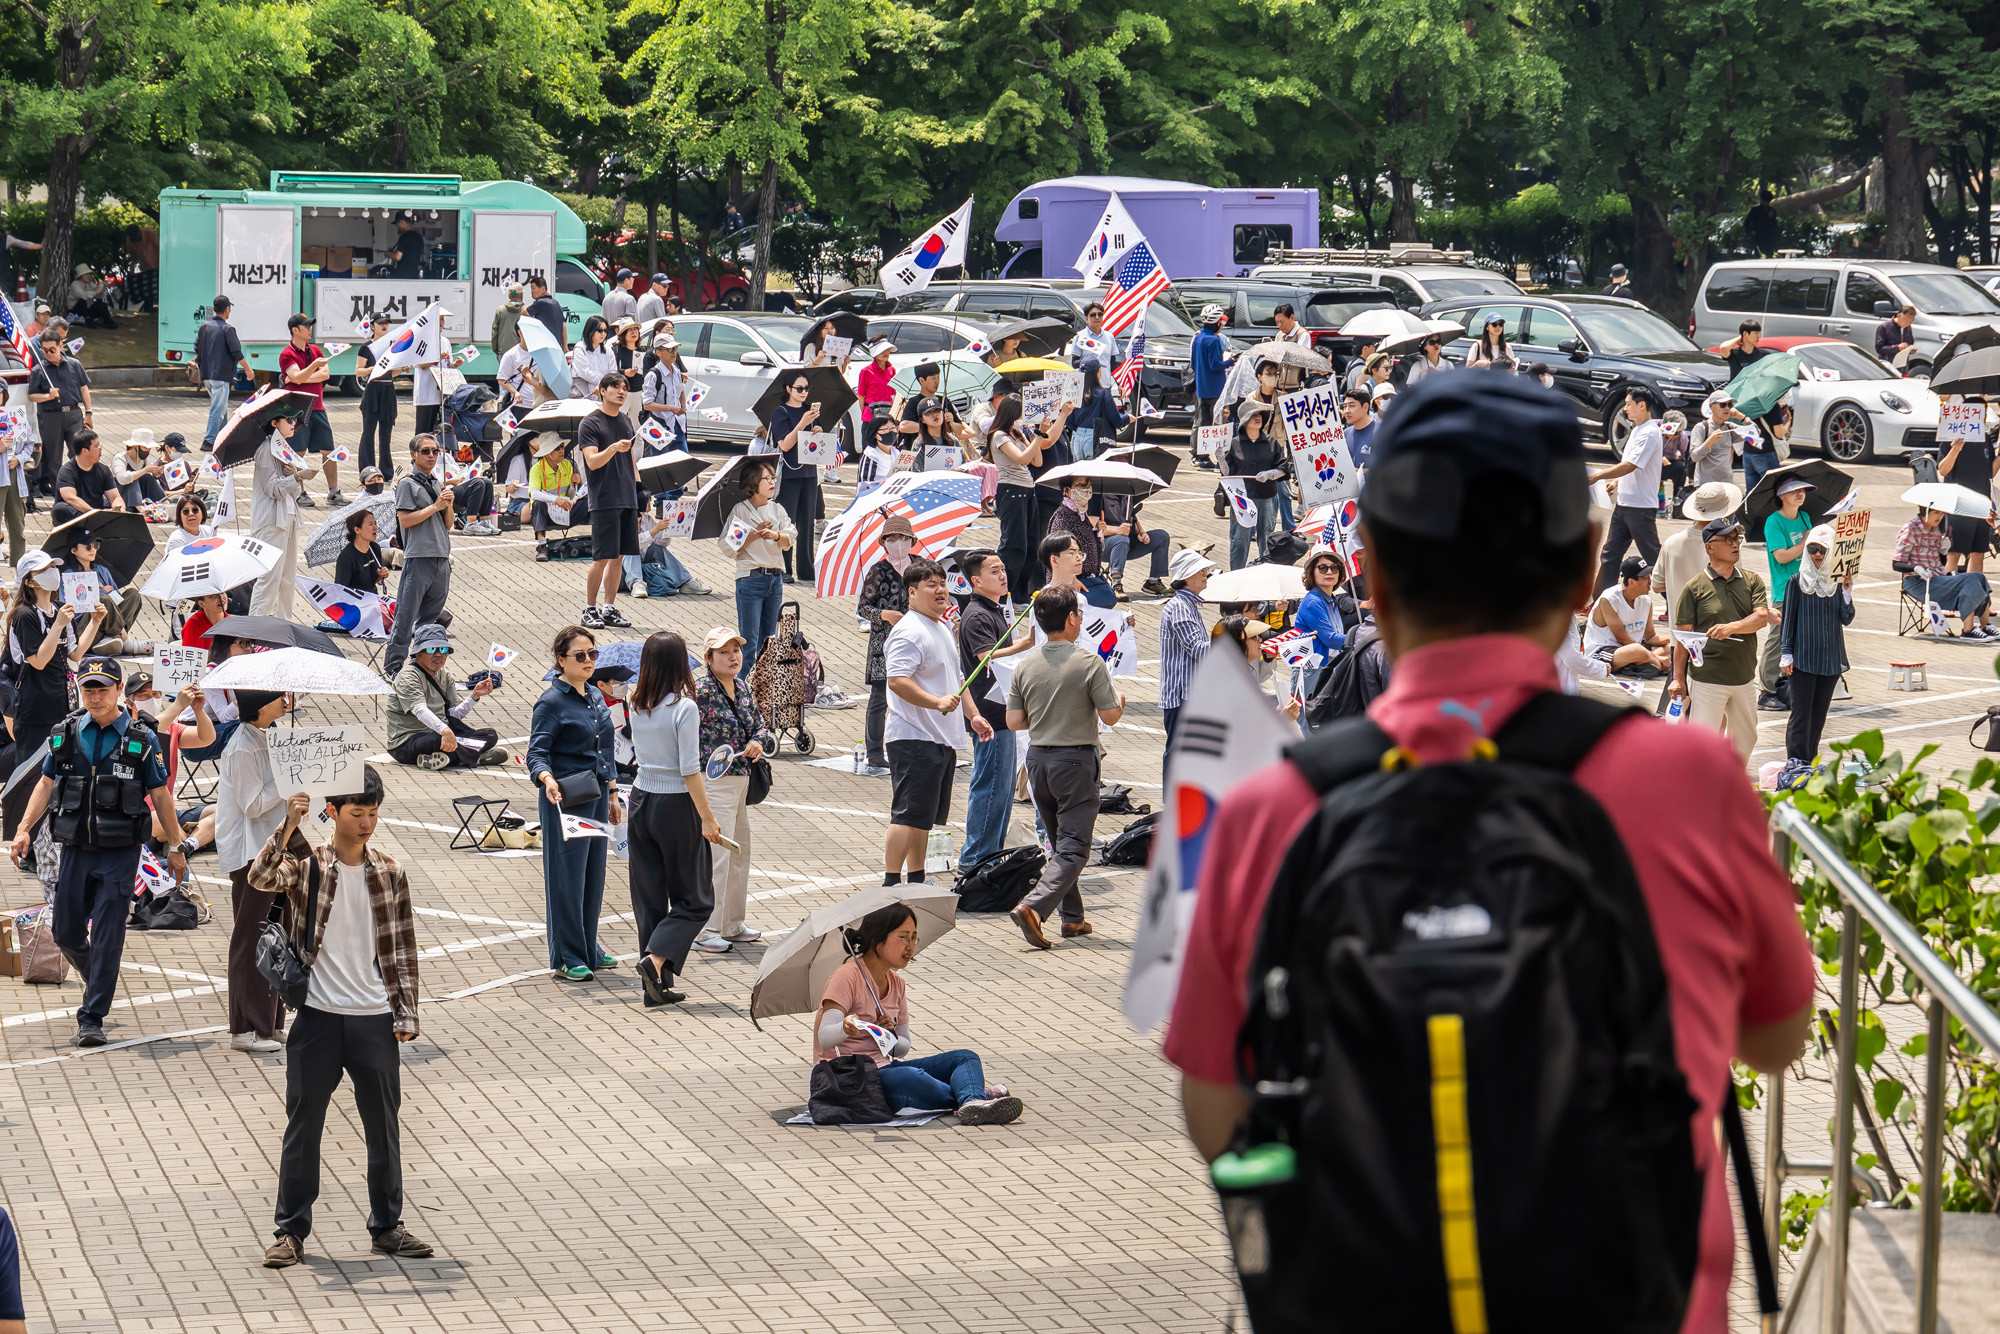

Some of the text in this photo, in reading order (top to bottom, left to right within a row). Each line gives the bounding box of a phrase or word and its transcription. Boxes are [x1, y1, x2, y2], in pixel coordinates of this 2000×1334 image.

[228, 264, 287, 284] 재선거!
[1284, 391, 1337, 431] 부정선거
[1942, 405, 1981, 420] 부정선거
[1836, 510, 1871, 538] 부정선거
[1834, 534, 1867, 557] 재선거
[160, 648, 203, 667] 당일투표
[268, 731, 345, 748] Election Fraud
[313, 742, 364, 761] ALLIANCE
